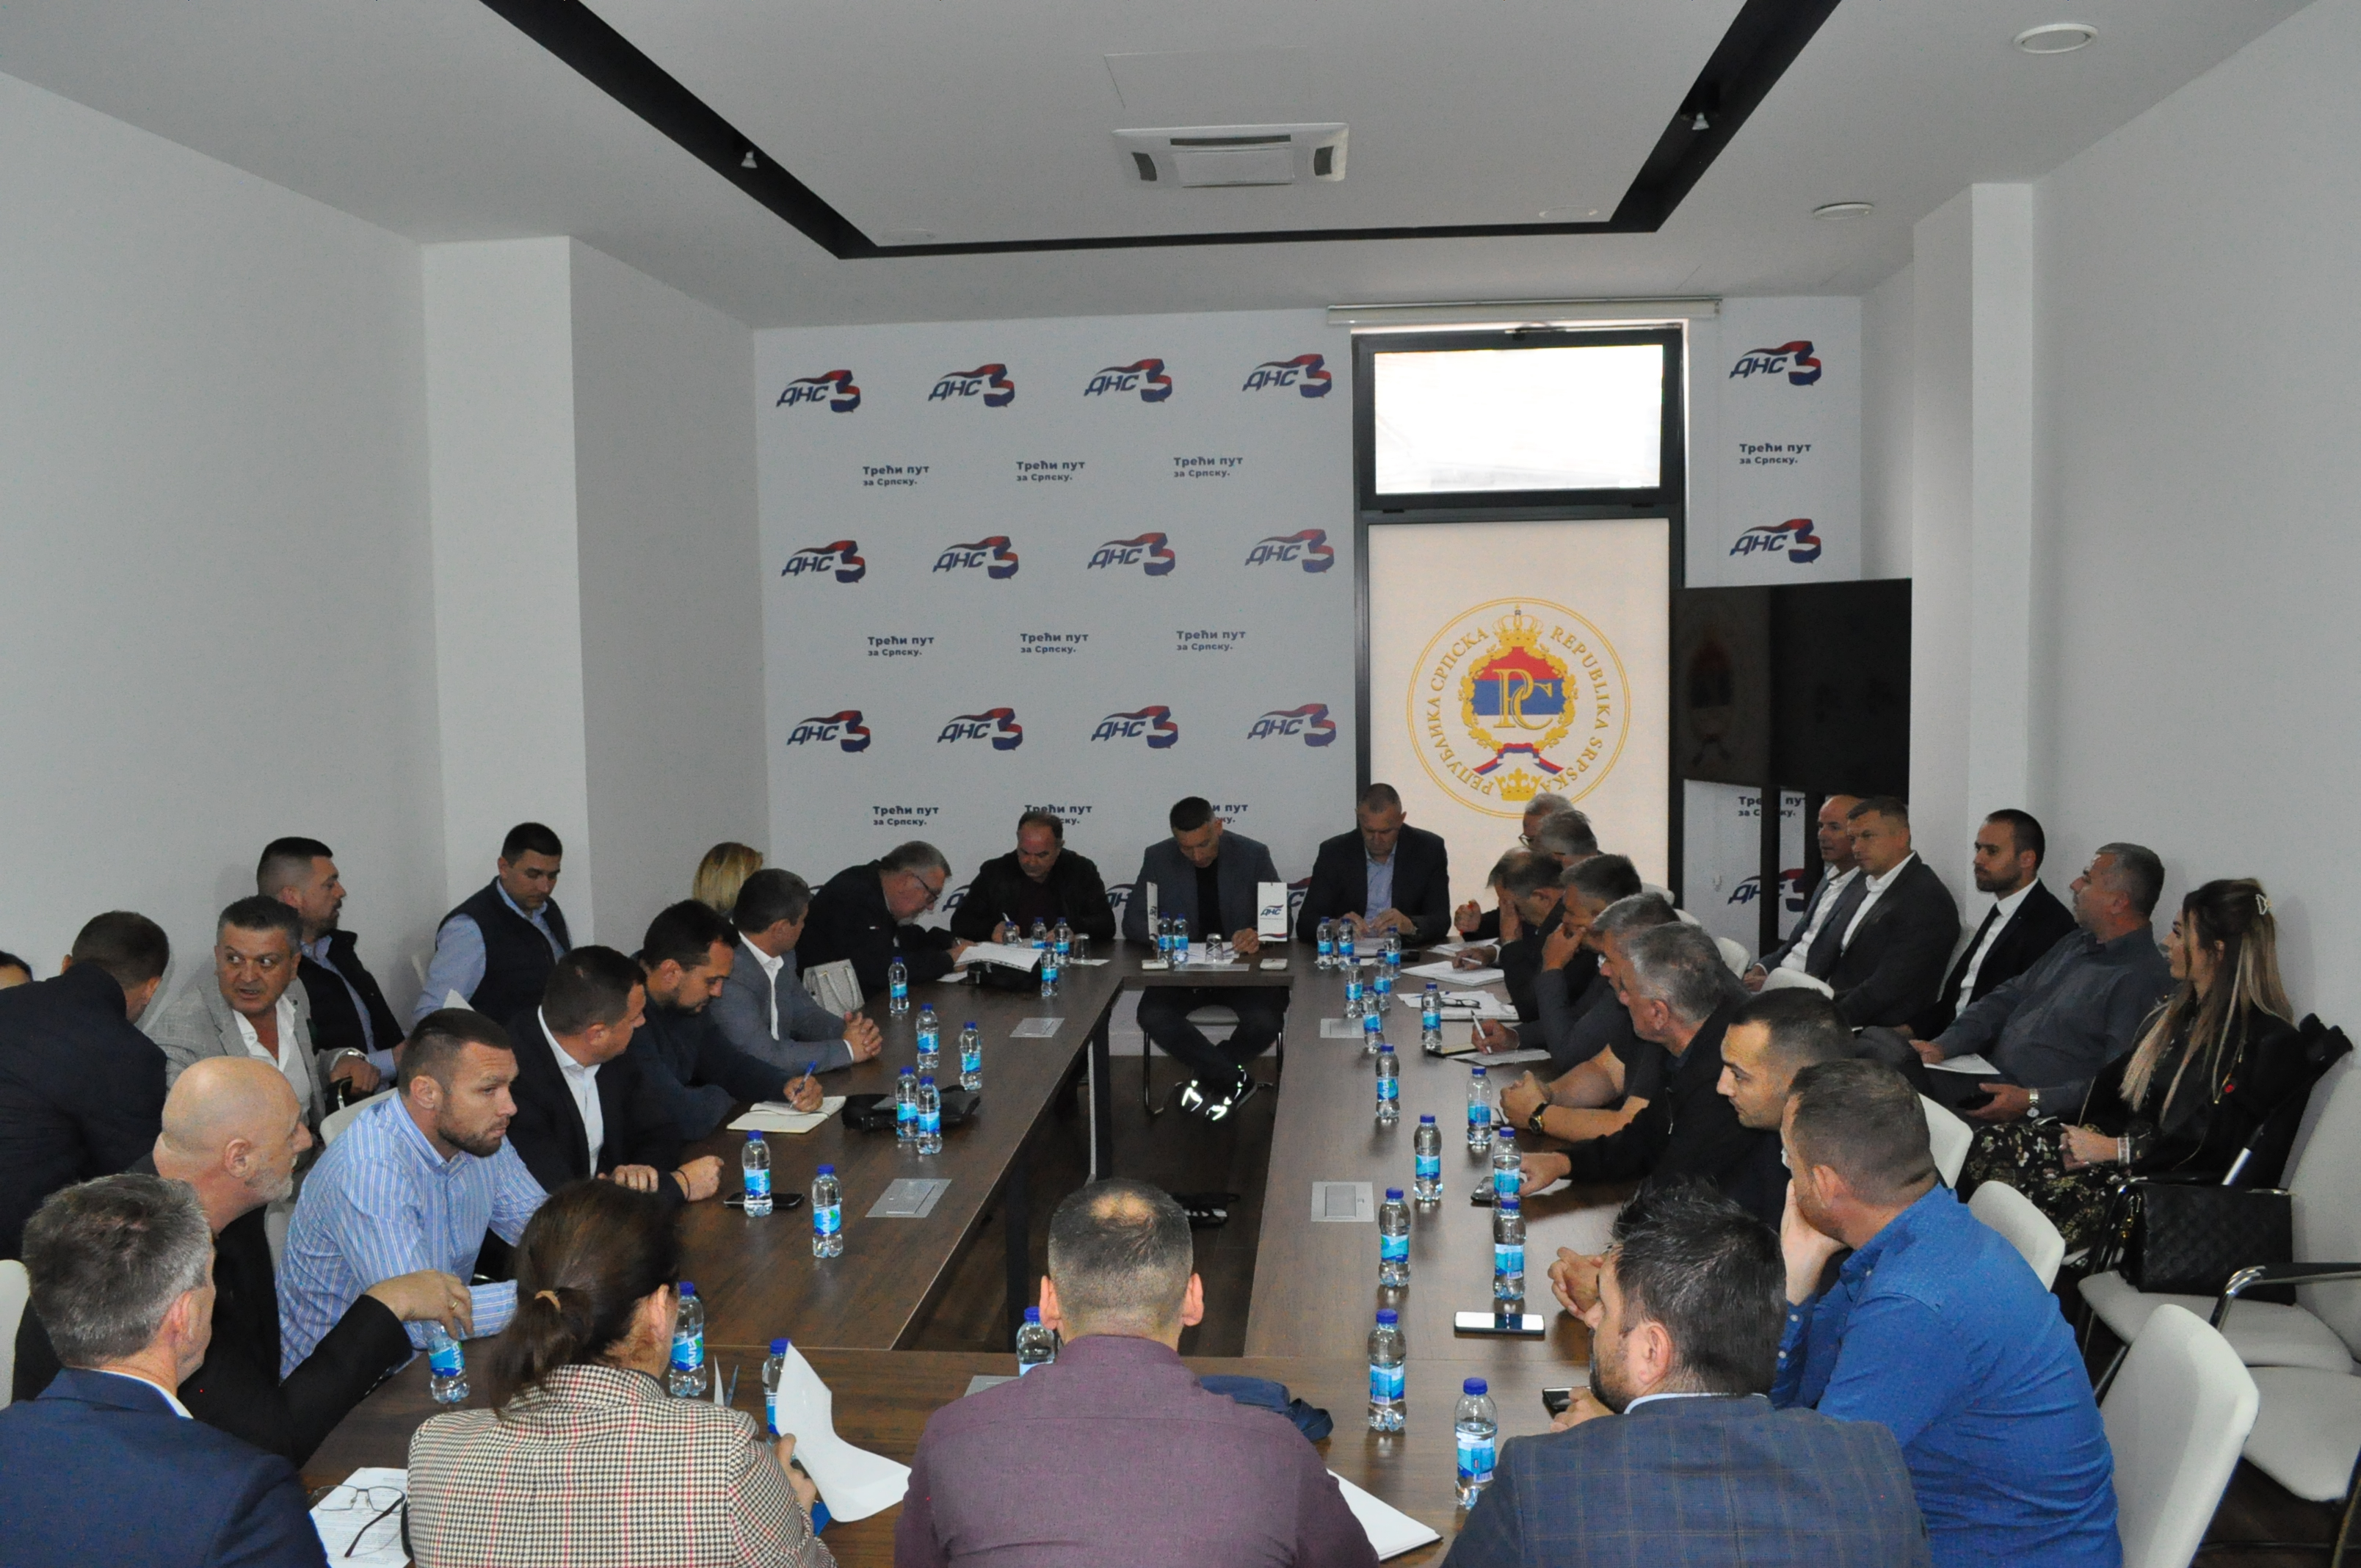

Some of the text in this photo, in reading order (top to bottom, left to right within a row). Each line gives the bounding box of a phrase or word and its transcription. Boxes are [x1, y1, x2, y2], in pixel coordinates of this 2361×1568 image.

[1730, 357, 1788, 379] ДНС
[1084, 374, 1139, 396] ДНС
[1243, 370, 1299, 391] ДНС
[776, 385, 830, 407] ДНС
[928, 379, 983, 401] ДНС
[1739, 443, 1811, 455] Трећи пут
[1016, 460, 1085, 472] Трећи пут
[1174, 457, 1243, 468] Трећи пут
[1755, 457, 1798, 465] Српску.
[863, 465, 929, 477] Трећи пут
[1189, 470, 1230, 478] Српску.
[877, 478, 918, 487] Српску.
[1031, 473, 1073, 482] Српску.
[1730, 534, 1788, 556] ДНС
[1088, 548, 1142, 569] ДНС
[1245, 545, 1301, 565] ДНС
[781, 556, 834, 576] ДНС
[932, 551, 987, 572] ДНС
[868, 636, 934, 647] Трећи пут
[1020, 632, 1089, 644] Трећи пут
[1176, 630, 1246, 642] Трећи пут
[882, 649, 922, 657] Српску.
[1035, 645, 1076, 654] Српску.
[1191, 643, 1233, 651] Српску.
[1431, 627, 1489, 692] СРПСКА
[1540, 625, 1611, 794] REPUBLIKA SRPSKA
[937, 723, 991, 743] ДНС
[1091, 721, 1146, 741] ДНС
[1247, 719, 1303, 738] ДНС
[787, 725, 839, 746] ДНС
[1738, 796, 1762, 807] Тре
[873, 805, 939, 817] Трећи пут
[1070, 805, 1092, 815] пут
[1225, 804, 1248, 814] пут
[887, 818, 927, 827] Српску.
